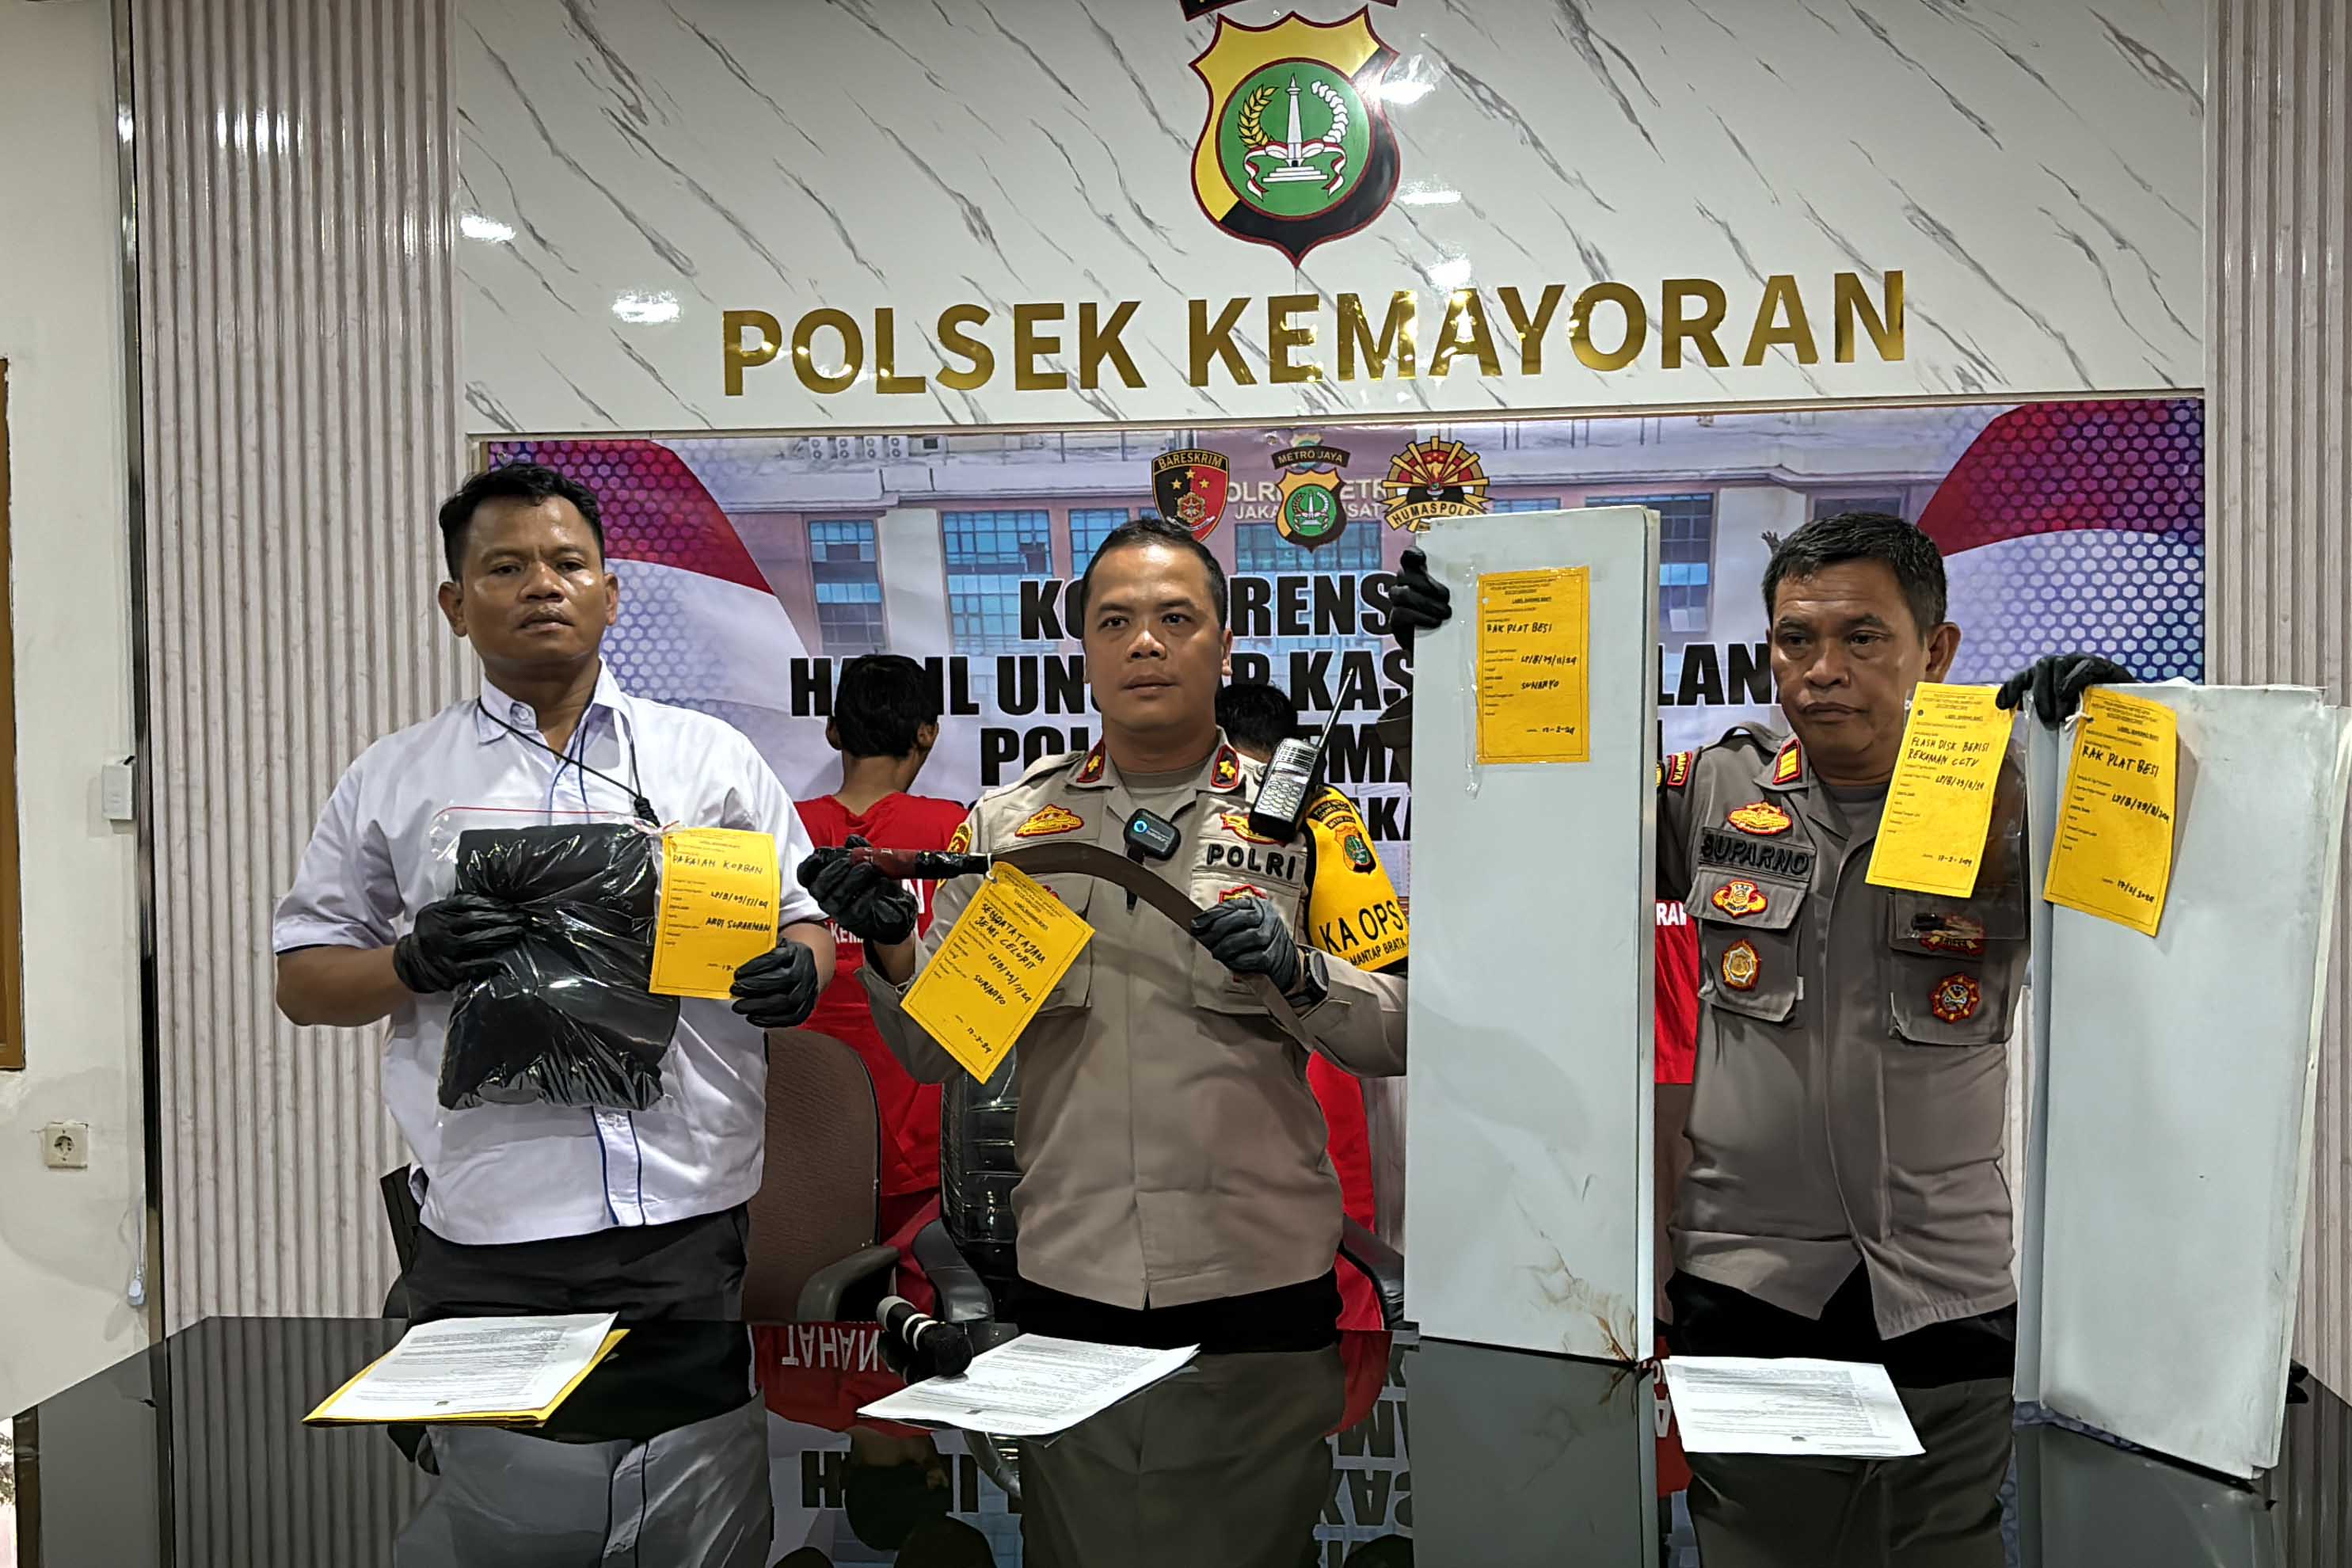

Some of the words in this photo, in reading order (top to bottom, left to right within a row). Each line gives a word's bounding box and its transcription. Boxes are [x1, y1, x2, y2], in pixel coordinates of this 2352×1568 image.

[723, 301, 1147, 396] POLSEK
[1189, 270, 1905, 389] KEMAYORAN
[1158, 451, 1223, 469] BARESKRIM
[1278, 451, 1315, 463] METRO
[1316, 450, 1343, 463] JAYA
[1235, 505, 1279, 519] JAKA
[1393, 503, 1481, 525] HUMASPOLR
[1532, 621, 1552, 634] BESI
[1907, 748, 1947, 765] REKAMAN
[1911, 736, 1935, 749] FLASH
[1938, 739, 1955, 751] DISK
[2082, 745, 2103, 764] RAK
[2107, 752, 2137, 772] PLAT
[2137, 759, 2160, 778] BESI
[1207, 843, 1296, 881] POLRI
[1700, 835, 1811, 877] SUPARNO
[1319, 917, 1360, 956] KA
[1359, 900, 1403, 941] OPS
[999, 938, 1037, 970] CELURIT
[1349, 946, 1382, 967] MANTAP
[1383, 937, 1406, 954] BRATA
